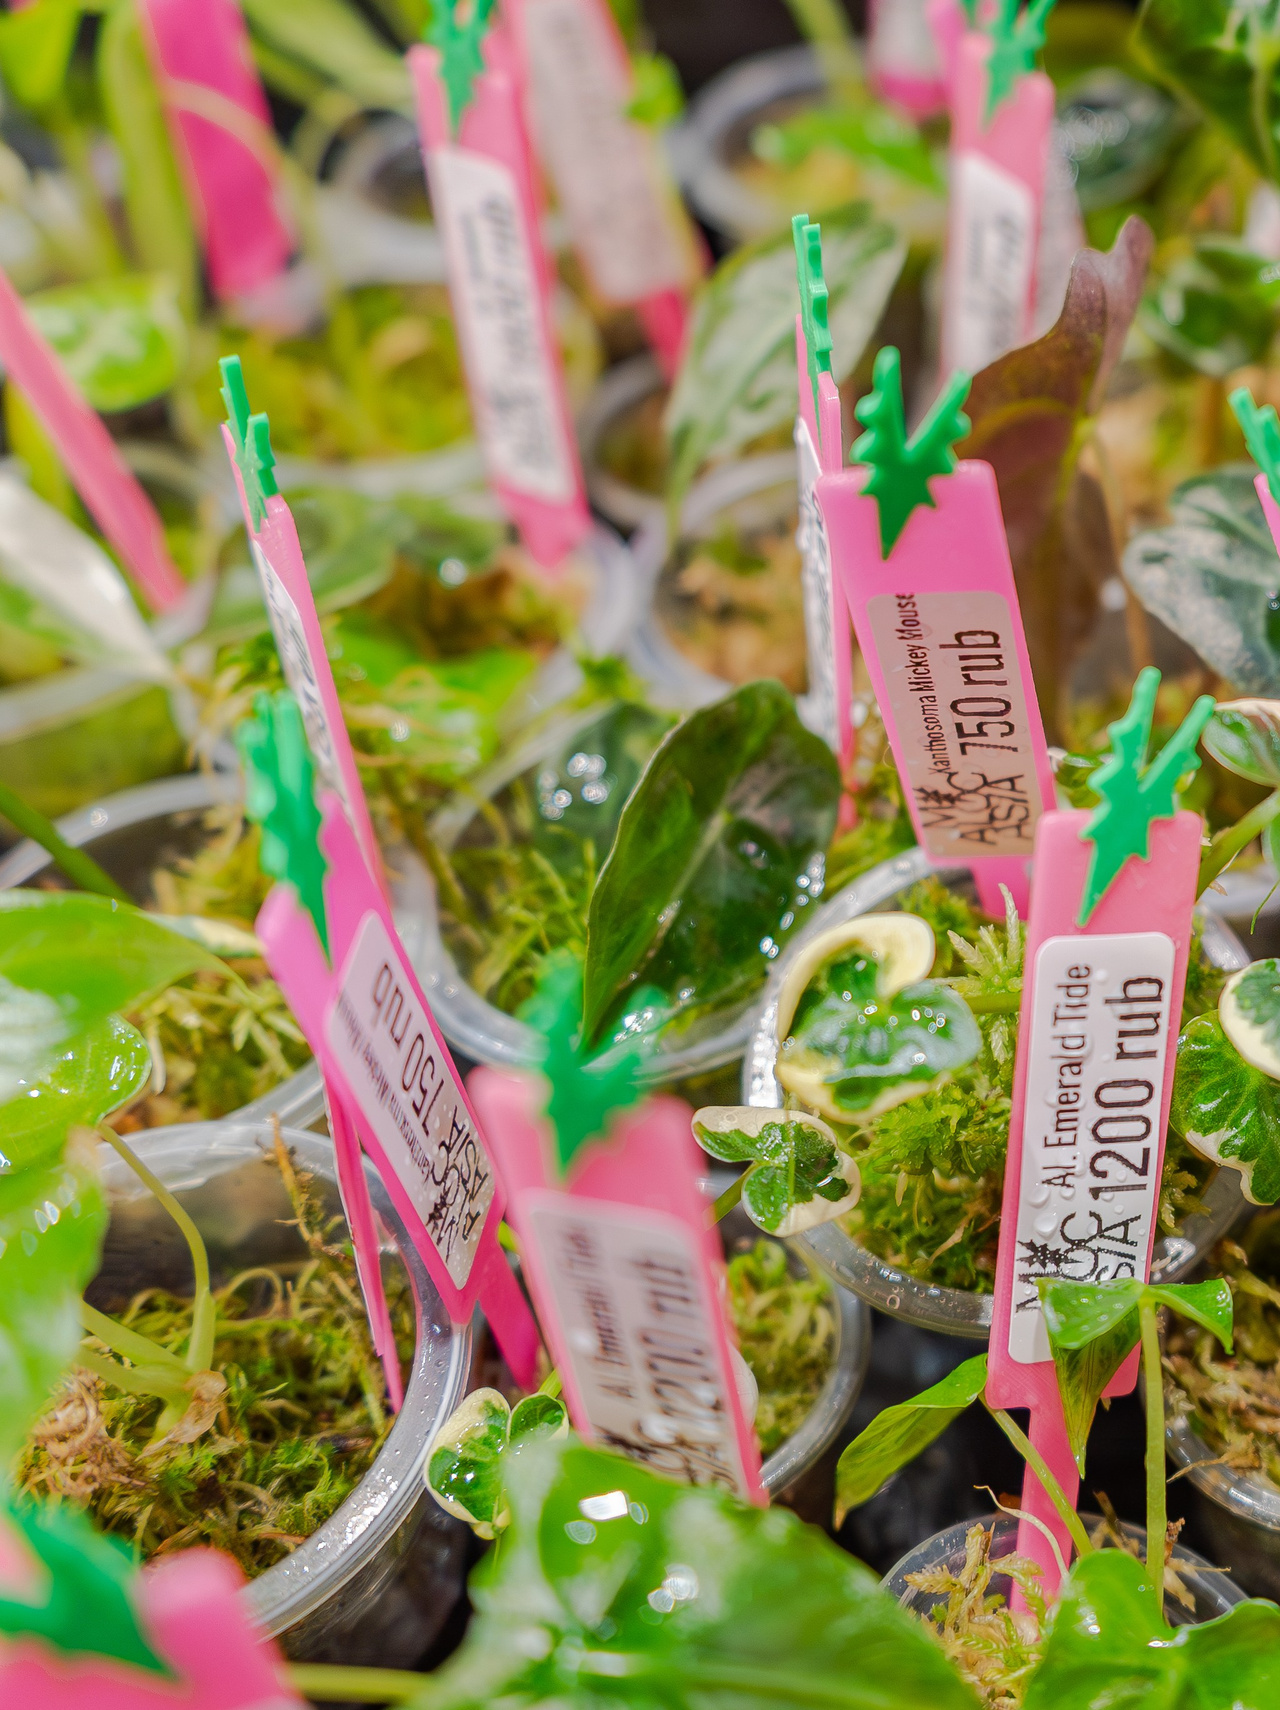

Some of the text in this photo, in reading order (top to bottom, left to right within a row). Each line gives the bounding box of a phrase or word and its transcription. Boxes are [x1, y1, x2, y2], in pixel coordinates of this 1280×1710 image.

[905, 644, 936, 692] Mickey
[919, 695, 951, 774] Xanthosoma
[938, 630, 1018, 756] 750 rub
[372, 960, 444, 1137] 750 rub
[1042, 963, 1091, 1189] Al. Emerald Tide
[1088, 977, 1164, 1200] 1200 rub
